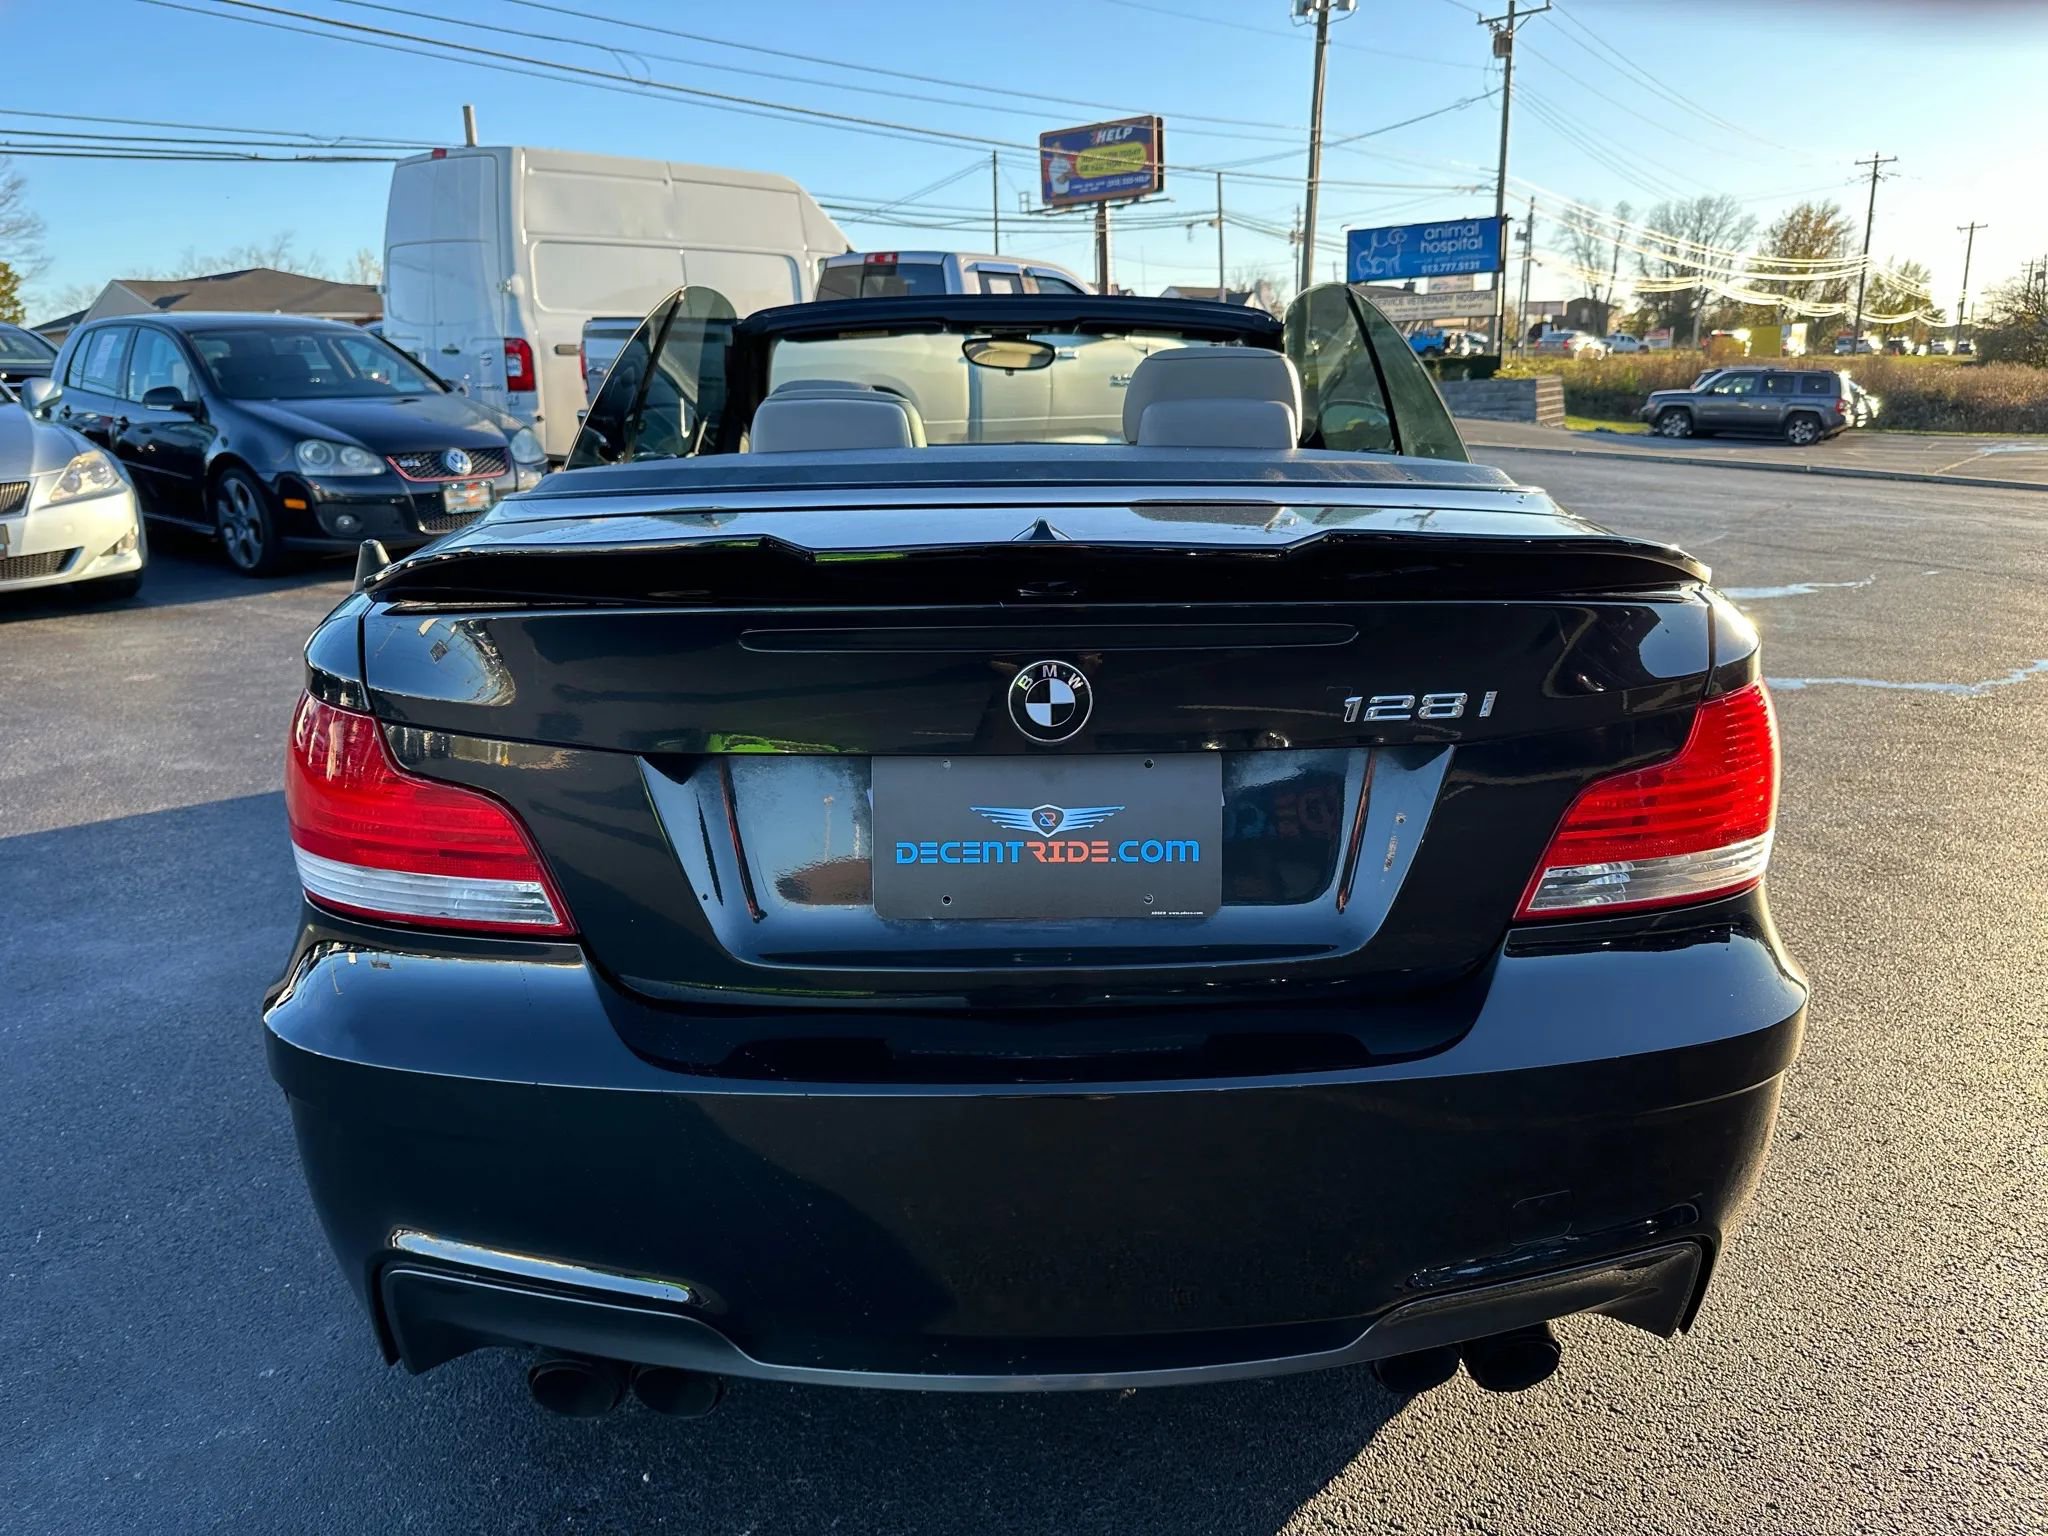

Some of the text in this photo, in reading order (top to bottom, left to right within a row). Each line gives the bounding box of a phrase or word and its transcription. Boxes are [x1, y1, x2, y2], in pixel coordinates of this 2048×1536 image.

[1097, 127, 1133, 142] HELP
[1424, 222, 1480, 241] animal
[1420, 236, 1483, 254] hospital
[1406, 293, 1454, 304] VETERINARY
[1456, 291, 1494, 301] HOSPITAL
[1017, 664, 1084, 691] BMW
